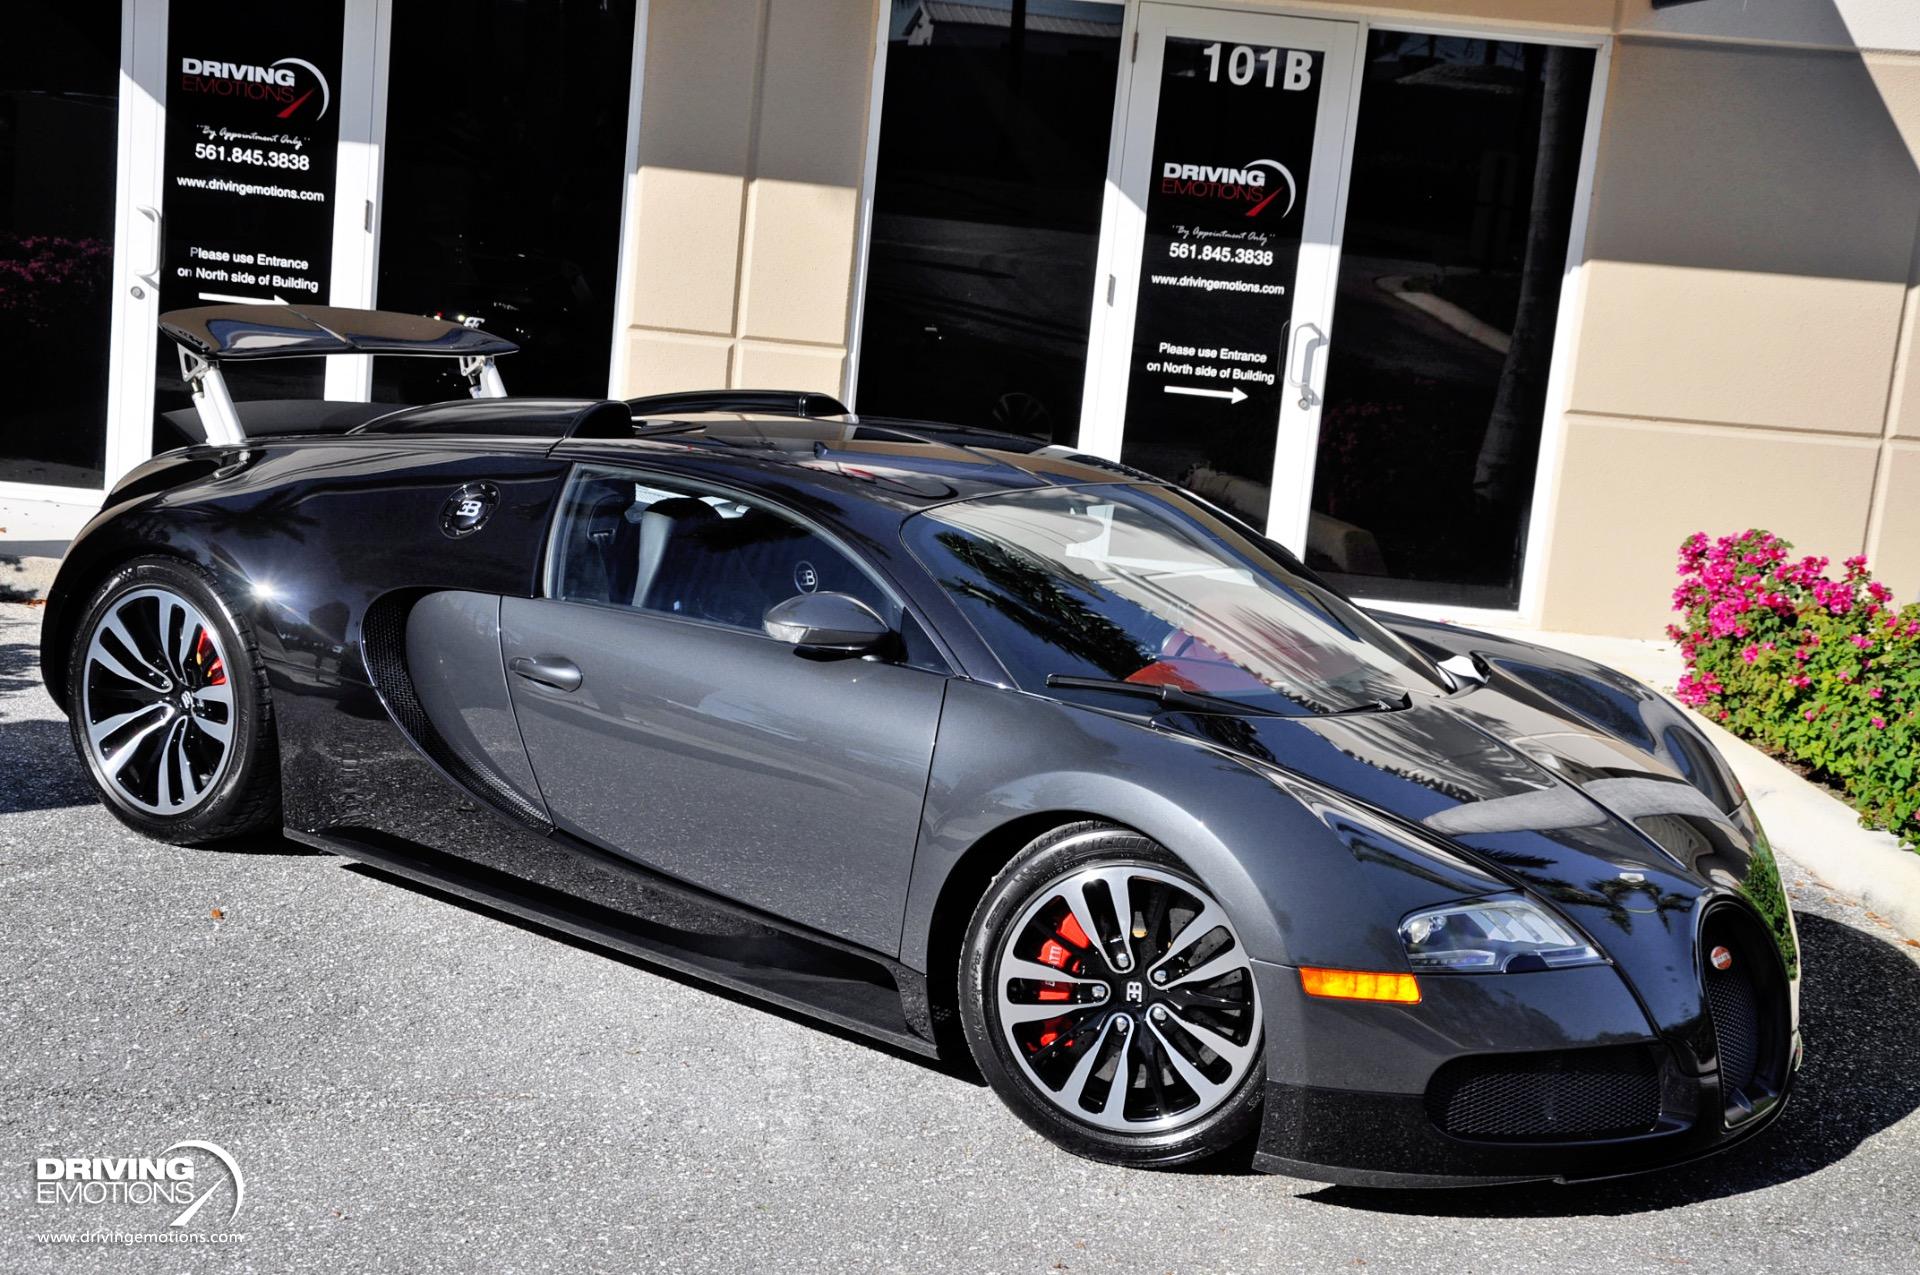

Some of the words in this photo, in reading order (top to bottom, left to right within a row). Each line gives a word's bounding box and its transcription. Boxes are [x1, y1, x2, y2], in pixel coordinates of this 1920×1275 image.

[182, 57, 296, 87] DRIVING
[1203, 42, 1313, 92] 101B
[182, 76, 295, 103] EMOTIONS
[195, 143, 310, 170] 561.845.3838
[1163, 162, 1266, 187] DRIVING
[177, 176, 325, 202] www.drivingemotions.com
[1161, 178, 1264, 201] EMOTIONS
[190, 247, 230, 263] Please
[232, 253, 254, 265] use
[257, 253, 309, 270] Entrance
[1169, 242, 1274, 266] 561.845.3838
[177, 267, 192, 278] on
[195, 268, 229, 283] North
[231, 271, 256, 285] side
[258, 274, 271, 286] of
[272, 276, 319, 293] Building
[1151, 274, 1285, 295] www.drivingemotions.com
[1159, 342, 1196, 356] Please
[1197, 348, 1218, 359] use
[1219, 348, 1267, 363] Entrance
[1146, 363, 1162, 373] on
[1163, 361, 1193, 376] North
[1195, 364, 1218, 378] side
[1219, 367, 1232, 379] of
[1232, 369, 1275, 384] Building
